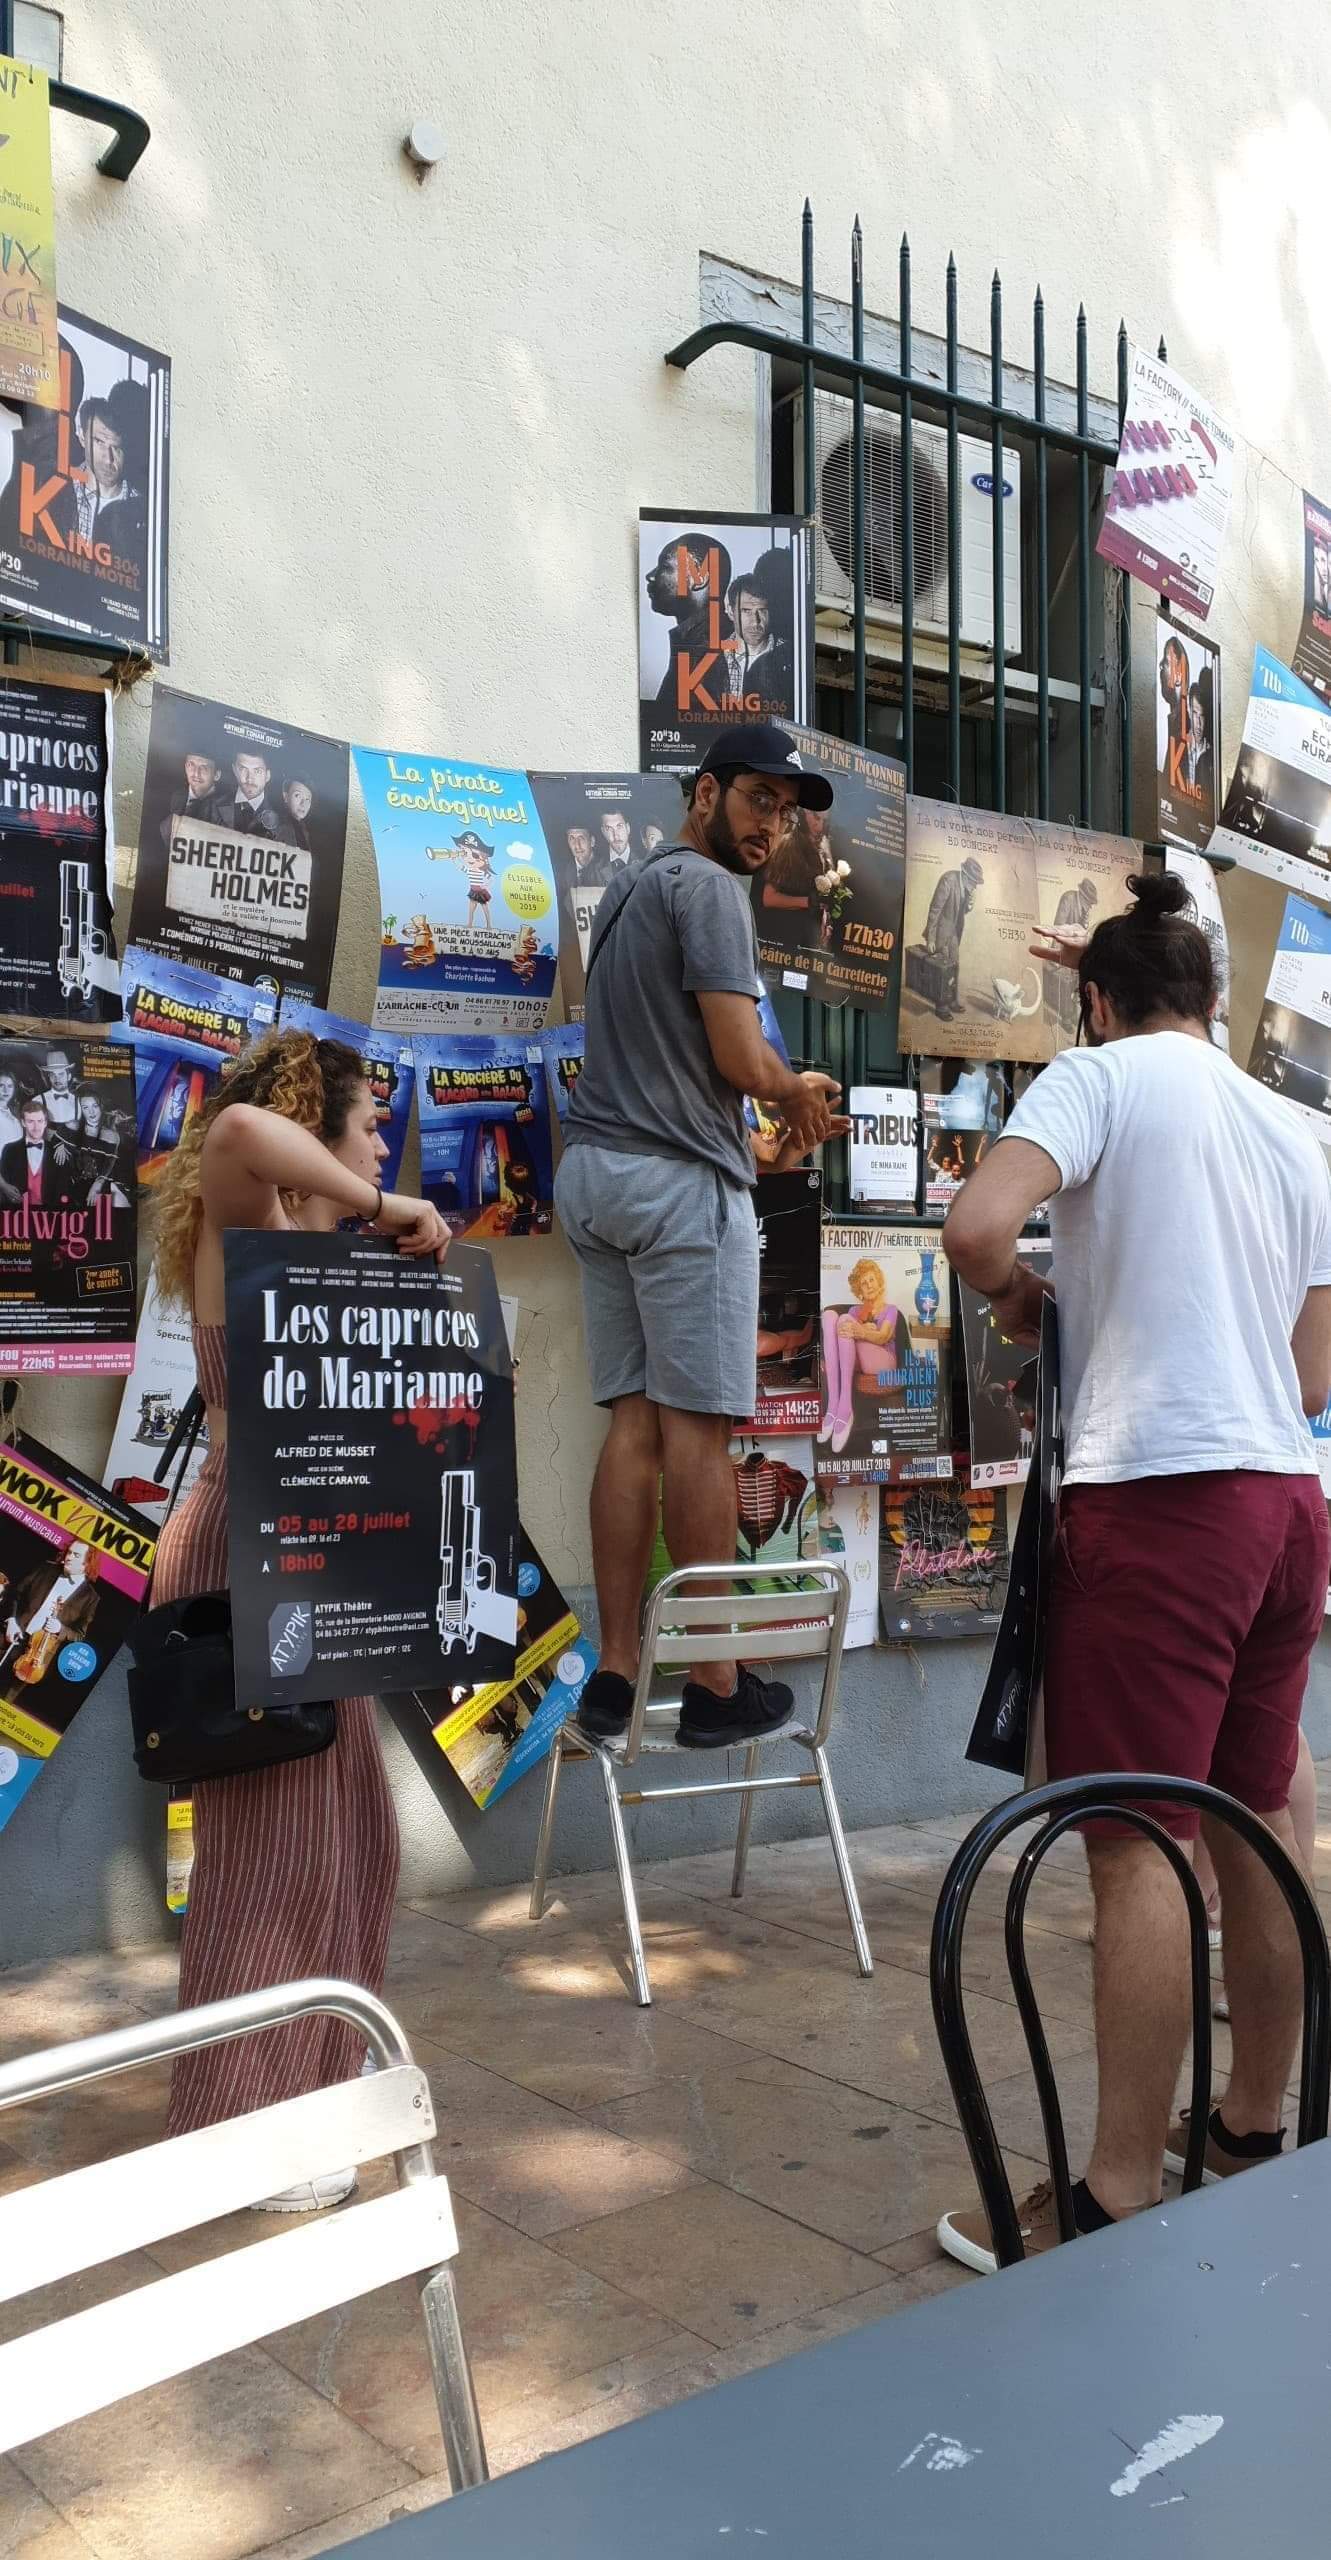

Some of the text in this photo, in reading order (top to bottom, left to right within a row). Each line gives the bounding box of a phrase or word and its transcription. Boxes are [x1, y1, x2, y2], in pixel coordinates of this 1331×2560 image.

[1135, 360, 1146, 377] LA
[1147, 369, 1183, 404] FACTORY
[20, 537, 141, 592] LORRAINE MOTEL
[677, 711, 743, 725] LORRAINE
[387, 756, 505, 796] La pirate
[820, 745, 905, 789] D'UNE INCONNUE
[960, 837, 999, 854] CONCERT
[171, 836, 298, 881] SHERLOCK
[210, 871, 309, 911] HOLMES
[843, 922, 895, 951] 17h30
[997, 927, 1027, 941] 15H30
[760, 946, 793, 967] éâtre
[794, 955, 811, 971] de
[811, 957, 825, 974] la
[227, 966, 243, 980] 17H
[136, 987, 242, 1035] LA SORCIÈRE DU
[511, 1000, 549, 1013] 10h05
[432, 1067, 523, 1087] LA SORCIÈRE DU
[827, 1229, 874, 1248] FACTORY
[914, 1234, 923, 1247] DE
[261, 1289, 480, 1360] Les caprices
[22, 1356, 56, 1370] 22h45
[262, 1355, 484, 1409] de Marianne
[877, 1367, 938, 1387] MOURAIENT
[785, 1400, 820, 1417] 14H25
[274, 1445, 377, 1458] ALFRED DE MUSSET
[850, 1458, 874, 1472] JUILLET
[873, 1457, 891, 1471] 2019
[280, 1474, 371, 1488] CLÉMENCE CARAYOL
[260, 1510, 411, 1535] DU 05 au 28 juillet
[90, 1516, 151, 1573] WOL
[280, 1552, 326, 1573] 18h10
[315, 1600, 373, 1614] ATYPIK Théâtre
[270, 1604, 311, 1673] ATYPIK
[317, 1652, 333, 1661] Tarif
